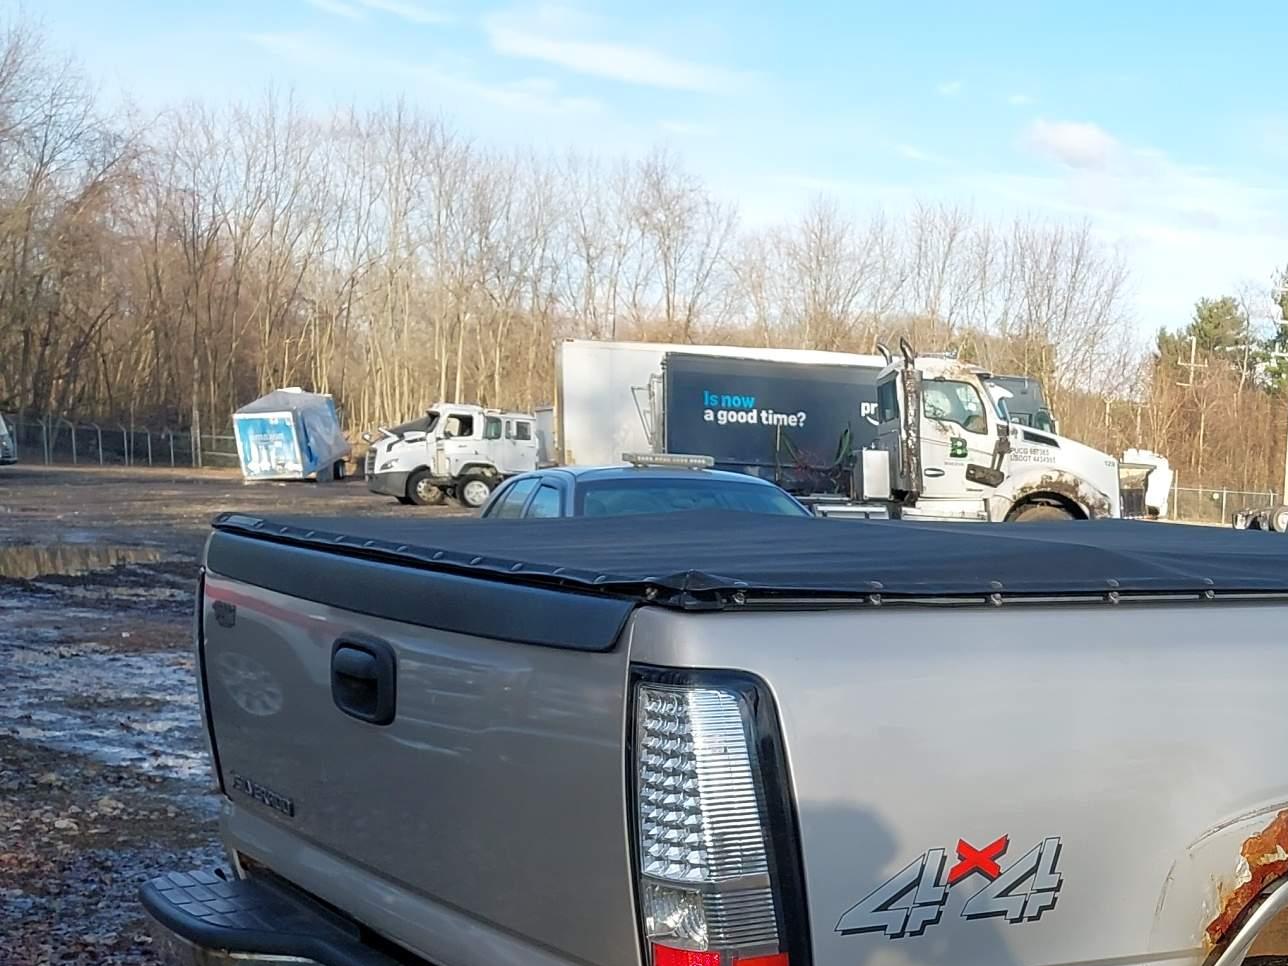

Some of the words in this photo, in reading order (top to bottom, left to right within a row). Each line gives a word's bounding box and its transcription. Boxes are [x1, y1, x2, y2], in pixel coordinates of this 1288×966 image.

[703, 390, 718, 406] Is
[721, 395, 755, 408] now
[704, 409, 714, 421] a
[717, 409, 758, 425] good
[760, 410, 807, 427] time?
[949, 437, 968, 458] B
